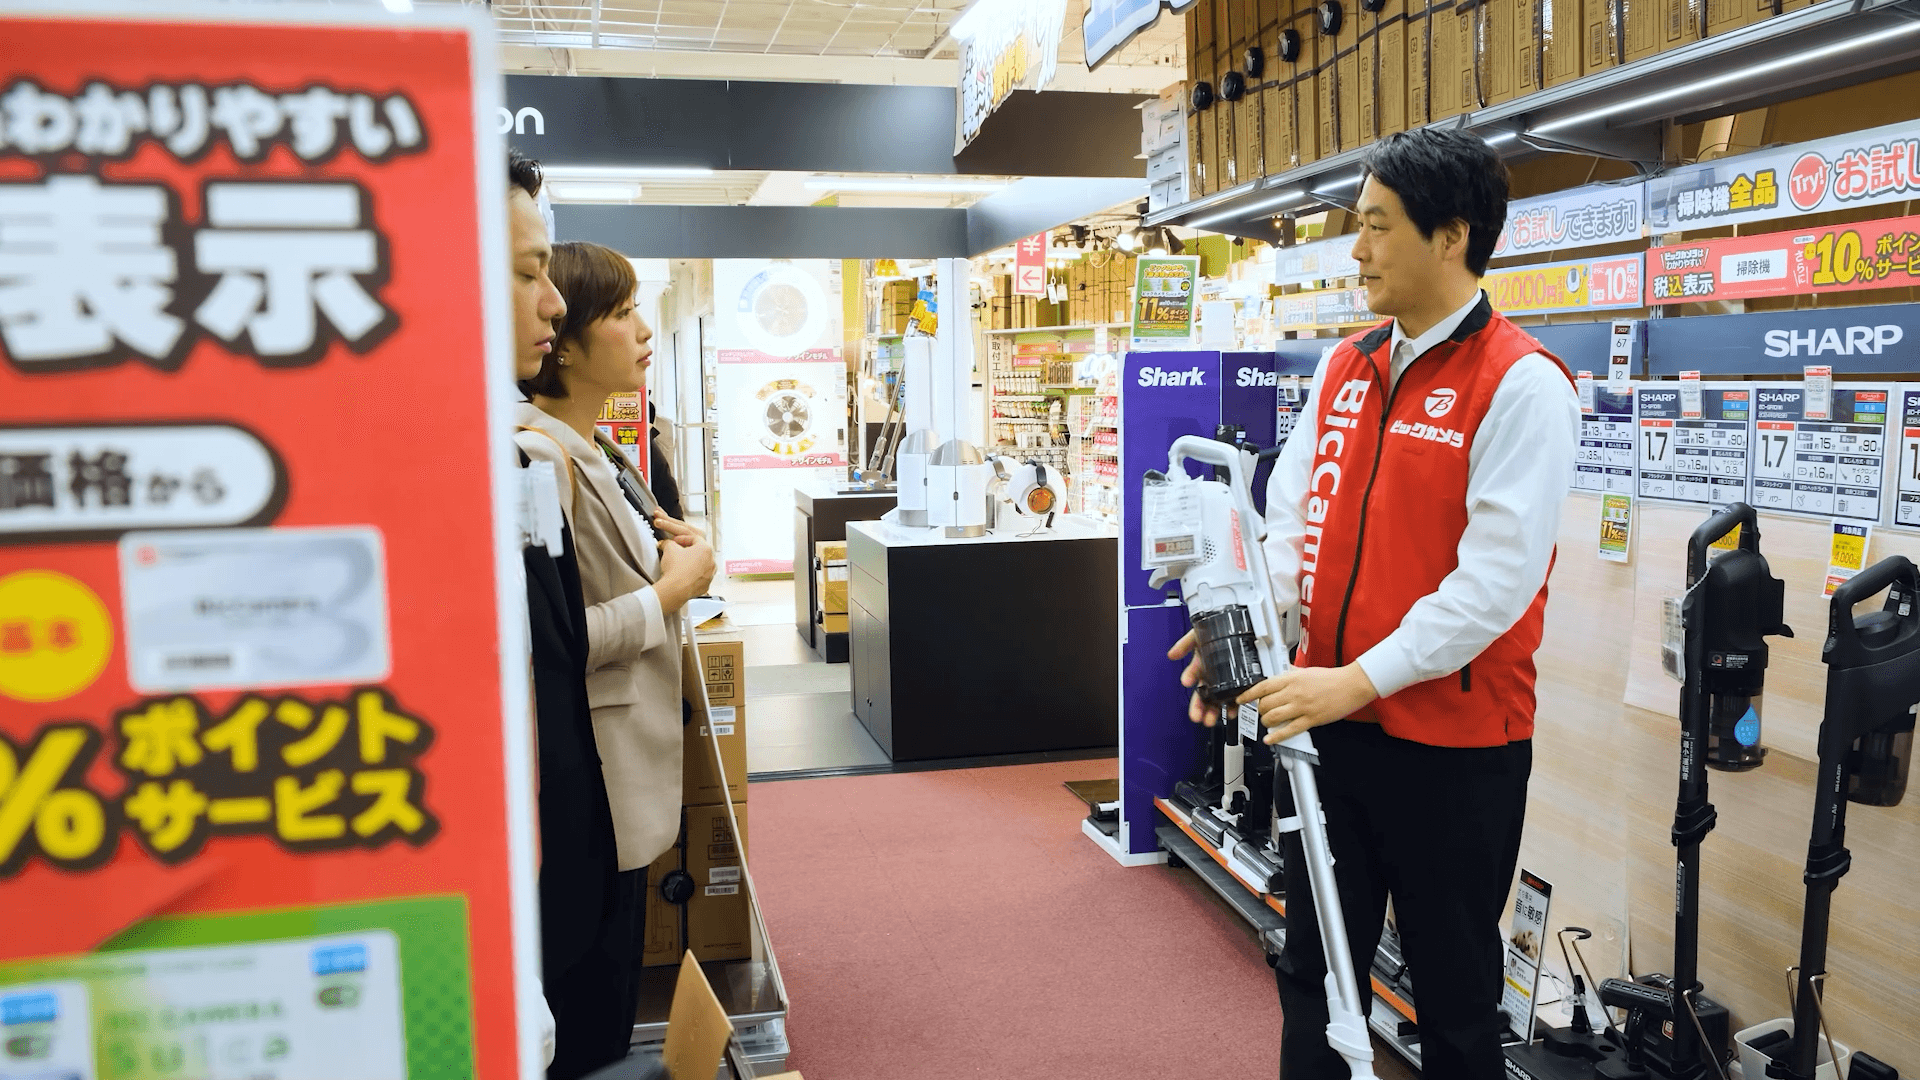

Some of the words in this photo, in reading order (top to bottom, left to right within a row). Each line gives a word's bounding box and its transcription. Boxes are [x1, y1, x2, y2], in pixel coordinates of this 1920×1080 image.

[1677, 171, 1777, 218] 掃除機全品
[1792, 165, 1825, 196] Try!
[0, 173, 386, 361] 表示
[1665, 259, 1703, 270] わかりやすい
[1737, 259, 1770, 276] 掃除機
[1795, 250, 1807, 285] さらに
[1654, 273, 1715, 297] 税込表示
[1616, 339, 1627, 348] 67
[1764, 325, 1904, 358] SHARP
[1615, 370, 1624, 380] 12
[1641, 394, 1676, 402] SHARP
[1758, 393, 1800, 402] SHARP
[1389, 420, 1465, 448] ビックカメラ
[1645, 431, 1668, 461] 1.7
[1762, 435, 1788, 468] 1.7
[1301, 379, 1371, 655] BicCamera
[121, 692, 421, 776] ポイント
[123, 770, 426, 852] サービス
[1515, 898, 1543, 926] 音に敏感
